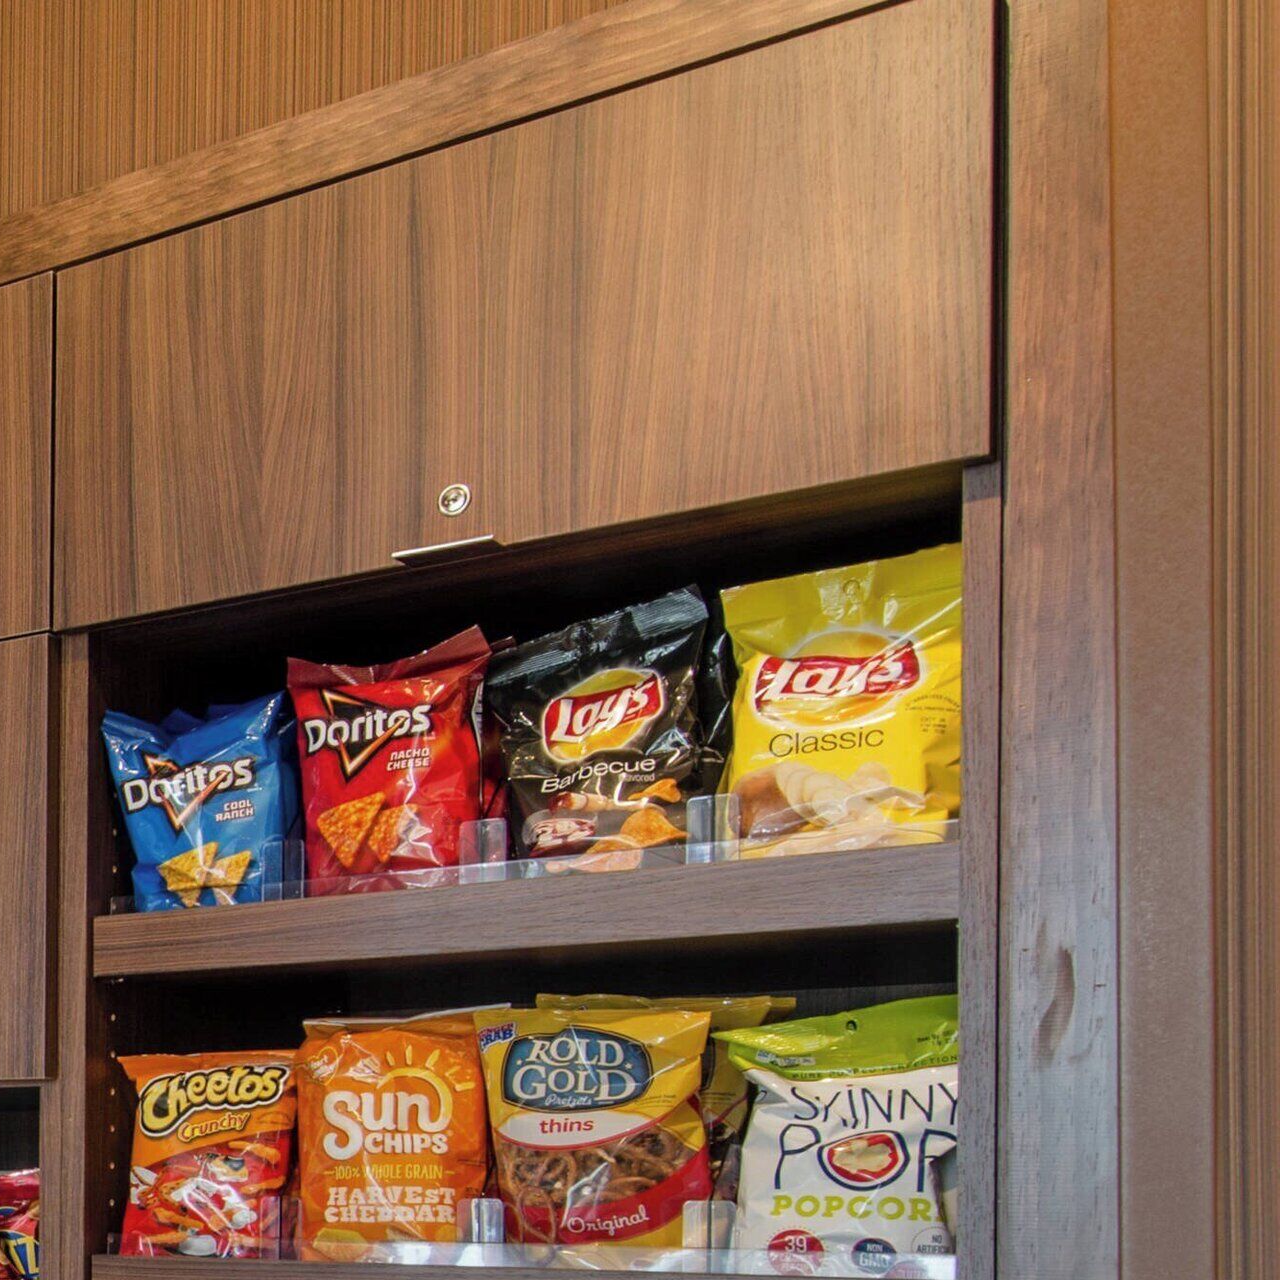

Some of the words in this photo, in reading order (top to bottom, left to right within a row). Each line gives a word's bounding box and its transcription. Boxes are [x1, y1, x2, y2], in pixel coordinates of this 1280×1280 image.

[759, 651, 905, 701] Lay's
[550, 679, 654, 743] Lay's
[303, 704, 433, 754] Doritos
[768, 727, 885, 758] Classic
[386, 756, 430, 771] CHEESE
[390, 747, 430, 759] NACHO
[123, 757, 256, 812] Doritos
[541, 757, 656, 793] Barbecue
[216, 807, 255, 822] RANCH
[223, 799, 253, 811] COOL
[527, 1037, 625, 1067] ROLD
[512, 1062, 636, 1101] GOLD
[141, 1066, 287, 1133] Cheetos
[544, 1093, 592, 1108] Pretzels
[177, 1112, 251, 1143] Crunchy
[323, 1088, 450, 1161] Sun
[539, 1116, 594, 1134] thins
[363, 1132, 449, 1154] CHIPS
[333, 1165, 362, 1180] 100%
[365, 1164, 402, 1179] WHOLE
[405, 1163, 443, 1179] GRAIN
[327, 1186, 456, 1205] HARVEST
[770, 1195, 945, 1222] POPCOR
[324, 1204, 457, 1224] CHEDDAR
[566, 1205, 650, 1240] Original
[784, 1236, 807, 1254] 39
